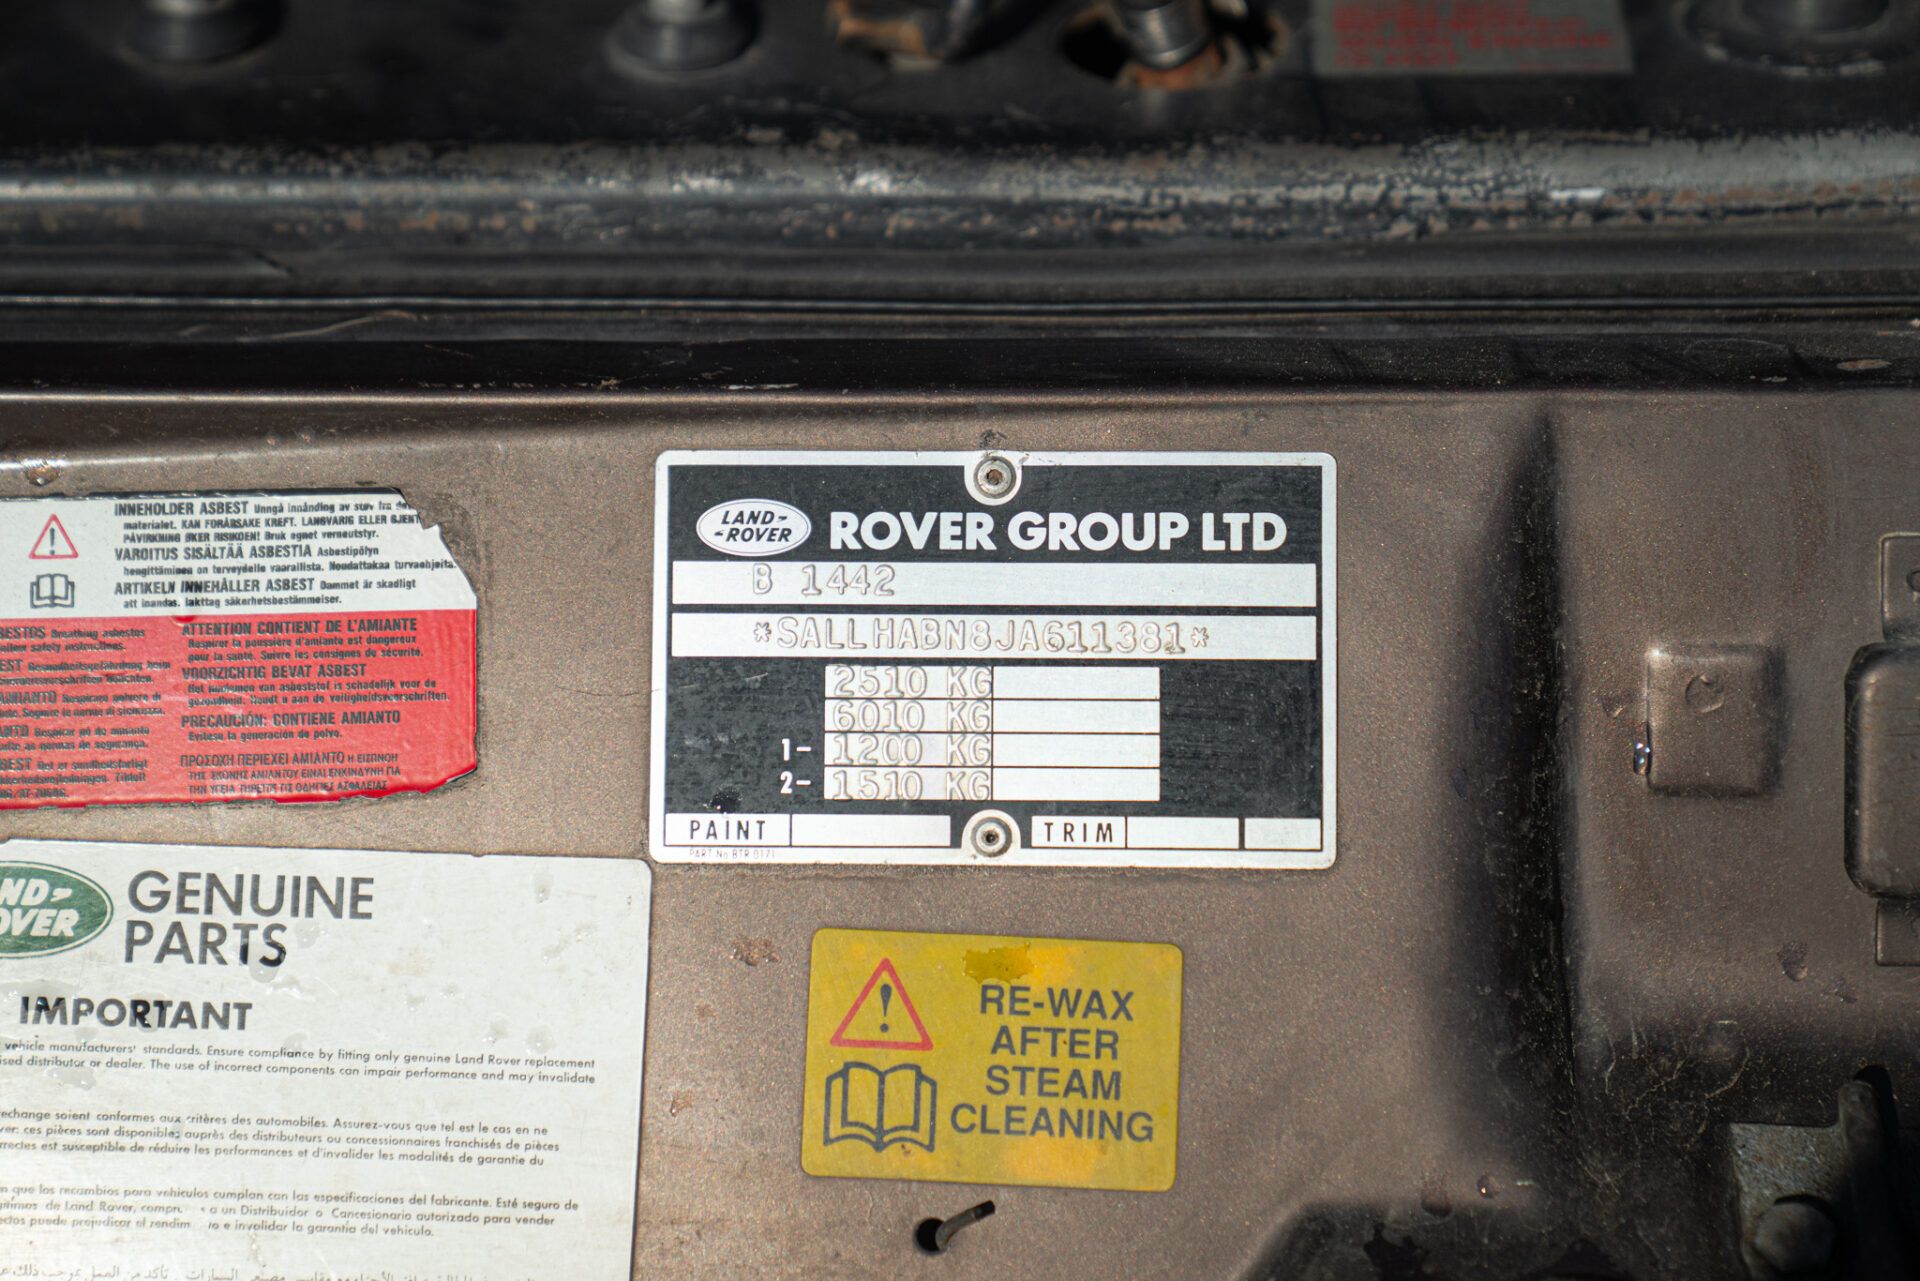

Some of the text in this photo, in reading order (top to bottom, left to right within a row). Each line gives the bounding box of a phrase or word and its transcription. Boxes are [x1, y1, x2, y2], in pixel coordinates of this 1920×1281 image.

[115, 502, 194, 516] INNEHOLDER
[200, 501, 248, 515] ASBEST
[254, 503, 284, 515] Unngå
[288, 502, 335, 513] innånding
[339, 503, 350, 511] av
[124, 520, 176, 530] materialet.
[182, 520, 200, 529] KAN
[265, 517, 296, 527] KREFT.
[359, 515, 386, 525] ELLER
[830, 511, 1287, 551] ROVER GROUP LTD
[115, 543, 379, 561] VAROITUS SISÄLTÄÄ ASBESTIA Asbestipölyn
[124, 566, 192, 577] hengittäminen
[197, 566, 208, 574] on
[270, 562, 324, 572] vaarallista.
[329, 560, 390, 571] Noudattakaa
[395, 558, 457, 571] turvaohjeita.
[752, 563, 896, 597] B 1442
[115, 577, 416, 595] ARTIKELN INNEHÅLLER ASBEST Dammet är skadligt
[124, 599, 137, 608] att
[142, 598, 180, 607] inandas.
[185, 597, 220, 608] Iakttag
[182, 618, 416, 636] ATTENTION CONTIENT DE L'AMIANTE
[182, 666, 266, 681] VOORZICHTIG
[272, 664, 312, 678] BEVAT
[317, 664, 366, 678] ASBEST
[833, 665, 992, 698] 2510 KG
[272, 712, 336, 727] CONTIENE
[341, 710, 400, 725] AMIANTO
[832, 700, 992, 732] 6010 KG
[833, 733, 923, 765] 1200
[946, 733, 992, 765] KG
[833, 769, 923, 801] 1510
[946, 769, 992, 801] KG
[689, 820, 766, 841] PAINT
[1044, 822, 1113, 843] TRIM
[128, 870, 374, 920] GENUINE
[124, 920, 288, 967] PARTS
[19, 996, 252, 1031] IMPORTANT
[979, 984, 1135, 1022] RE-WAX
[4, 1041, 45, 1052] vehicle
[143, 1045, 203, 1056] standards.
[206, 1047, 245, 1057] Ensure
[248, 1049, 315, 1060] compliance
[318, 1050, 334, 1063] by
[337, 1051, 371, 1064] fitting
[374, 1052, 400, 1064] only
[403, 1054, 451, 1065] genuine
[455, 1054, 484, 1065] Land
[487, 1055, 521, 1066] Rover
[524, 1057, 595, 1069] replacement
[990, 1025, 1120, 1060] AFTER
[26, 1057, 596, 1085] distributor or dealer. The use of incorrect components can impair performance and may invalidate
[985, 1065, 1122, 1101] STEAM
[54, 1112, 91, 1122] soient
[96, 1112, 156, 1123] conformes
[159, 1115, 182, 1124] aux
[231, 1116, 252, 1126] des
[255, 1117, 329, 1128] automobiles.
[332, 1119, 412, 1131] Assurez-vous
[414, 1123, 437, 1134] que
[440, 1122, 455, 1133] tel
[458, 1123, 475, 1133] est
[478, 1123, 490, 1134] le
[492, 1125, 511, 1135] cas
[515, 1126, 530, 1135] en
[533, 1127, 548, 1136] ne
[951, 1103, 1154, 1143] CLEANING
[23, 1126, 42, 1136] ces
[45, 1125, 83, 1138] pièces
[85, 1126, 110, 1137] sont
[184, 1130, 225, 1142] auprès
[228, 1130, 249, 1141] des
[251, 1131, 323, 1144] distributeurs
[326, 1135, 342, 1144] ou
[345, 1136, 441, 1148] concessionnaires
[444, 1137, 502, 1150] franchisés
[505, 1139, 521, 1151] de
[524, 1140, 560, 1153] pièces
[40, 1141, 544, 1167] est susceptible de réduire les performances et d'invalider les modalités de garantie du
